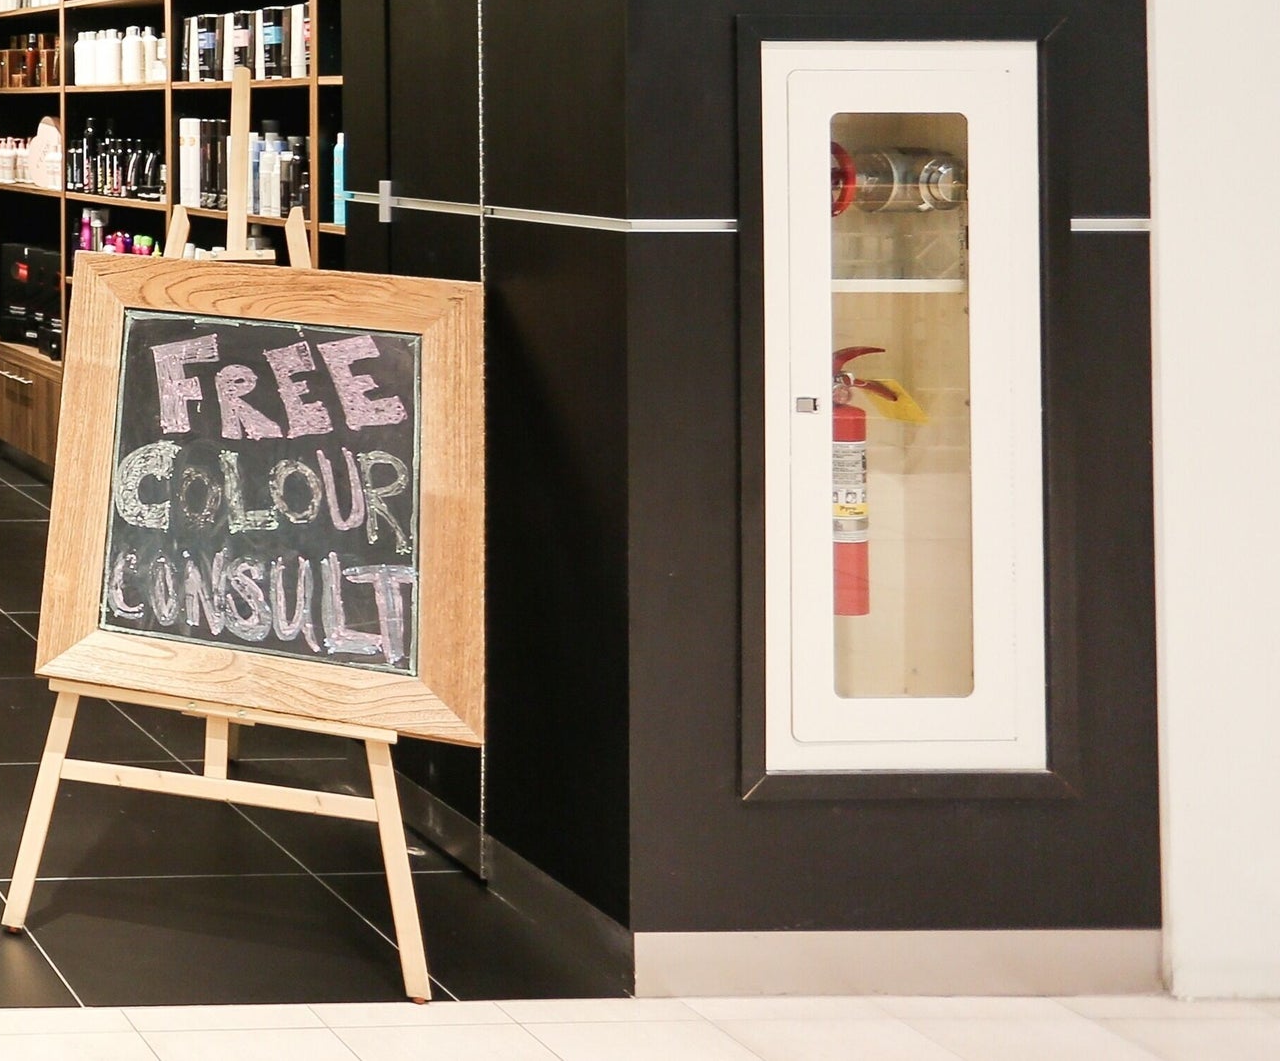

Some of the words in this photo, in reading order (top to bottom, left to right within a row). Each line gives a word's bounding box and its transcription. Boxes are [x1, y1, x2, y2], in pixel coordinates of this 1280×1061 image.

[150, 333, 409, 441] FREE
[114, 439, 412, 556] COLOUR
[106, 547, 419, 665] CONSULT
